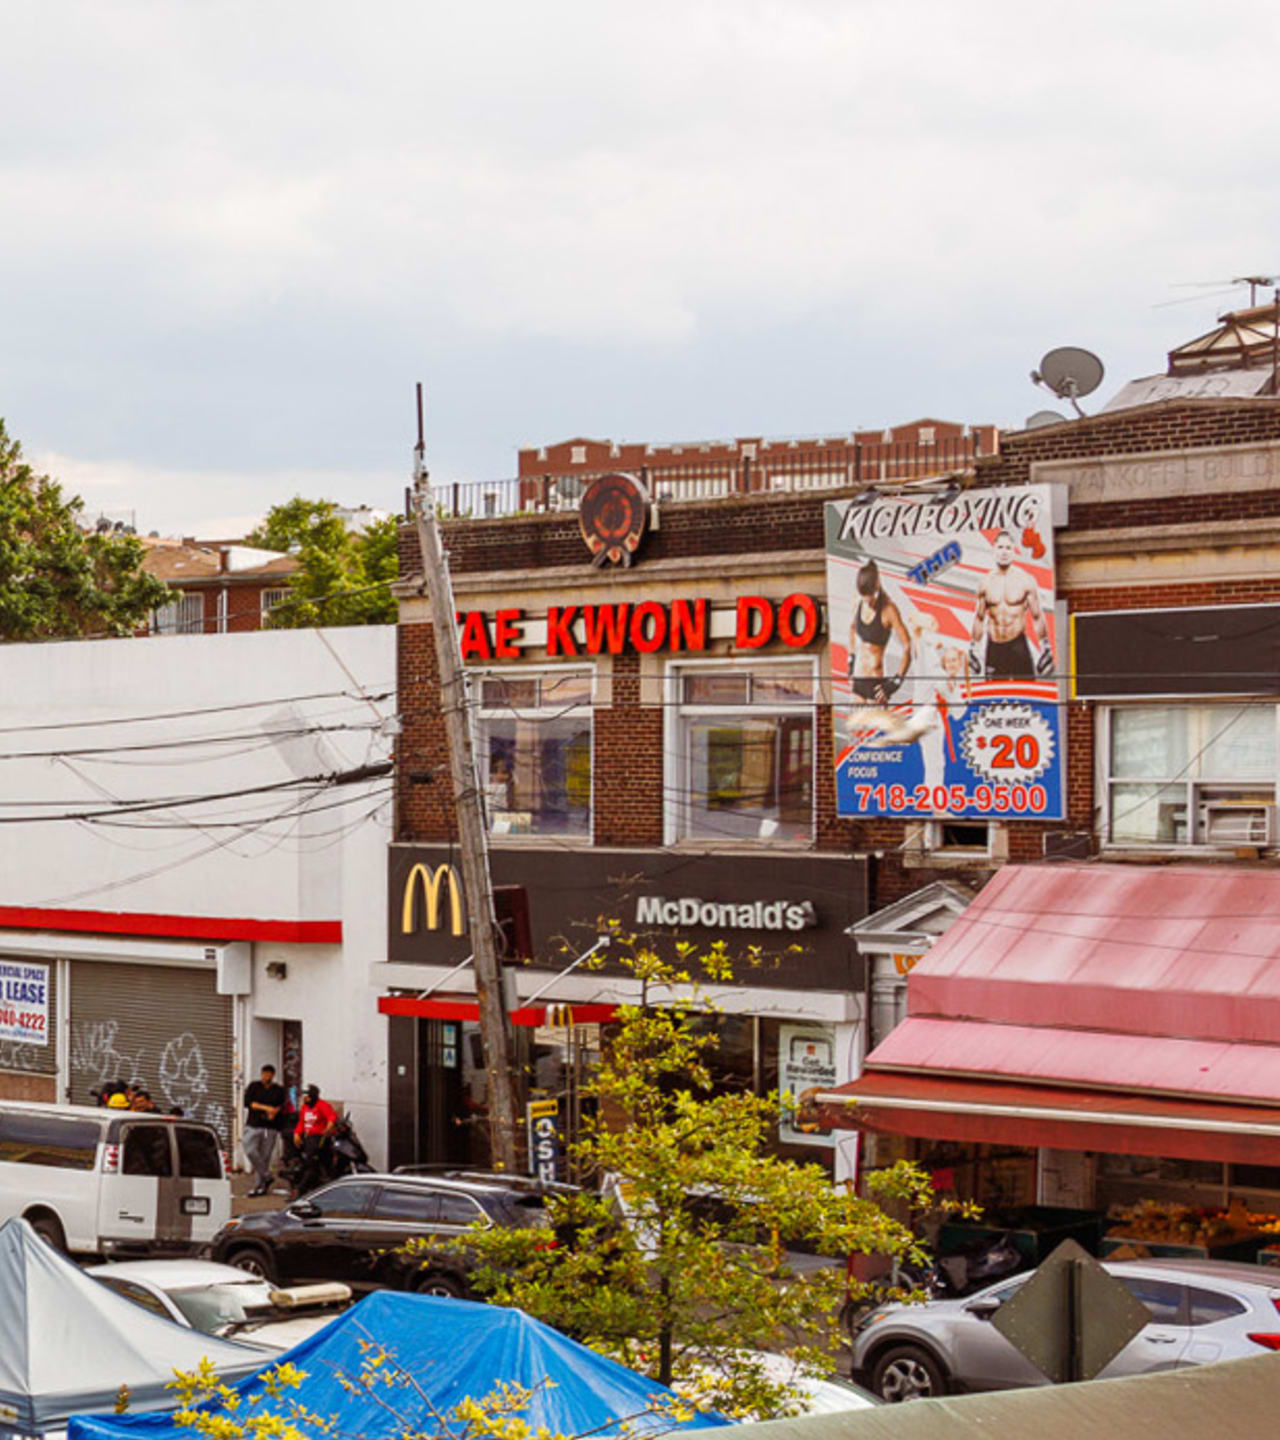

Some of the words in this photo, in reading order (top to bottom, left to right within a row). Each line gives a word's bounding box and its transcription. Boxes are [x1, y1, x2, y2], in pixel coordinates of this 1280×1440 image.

[839, 494, 1040, 540] KICKBOXING
[456, 609, 522, 659] AE
[546, 599, 707, 656] KWON
[735, 593, 819, 649] DO
[983, 717, 1003, 729] ONE
[1005, 717, 1031, 729] WEEK
[847, 751, 902, 763] CONFIDENCE
[848, 766, 878, 778] FOCUS
[855, 785, 1046, 811] 718-205-9500
[636, 896, 805, 930] McDonald's
[6, 981, 45, 1004] LEASE
